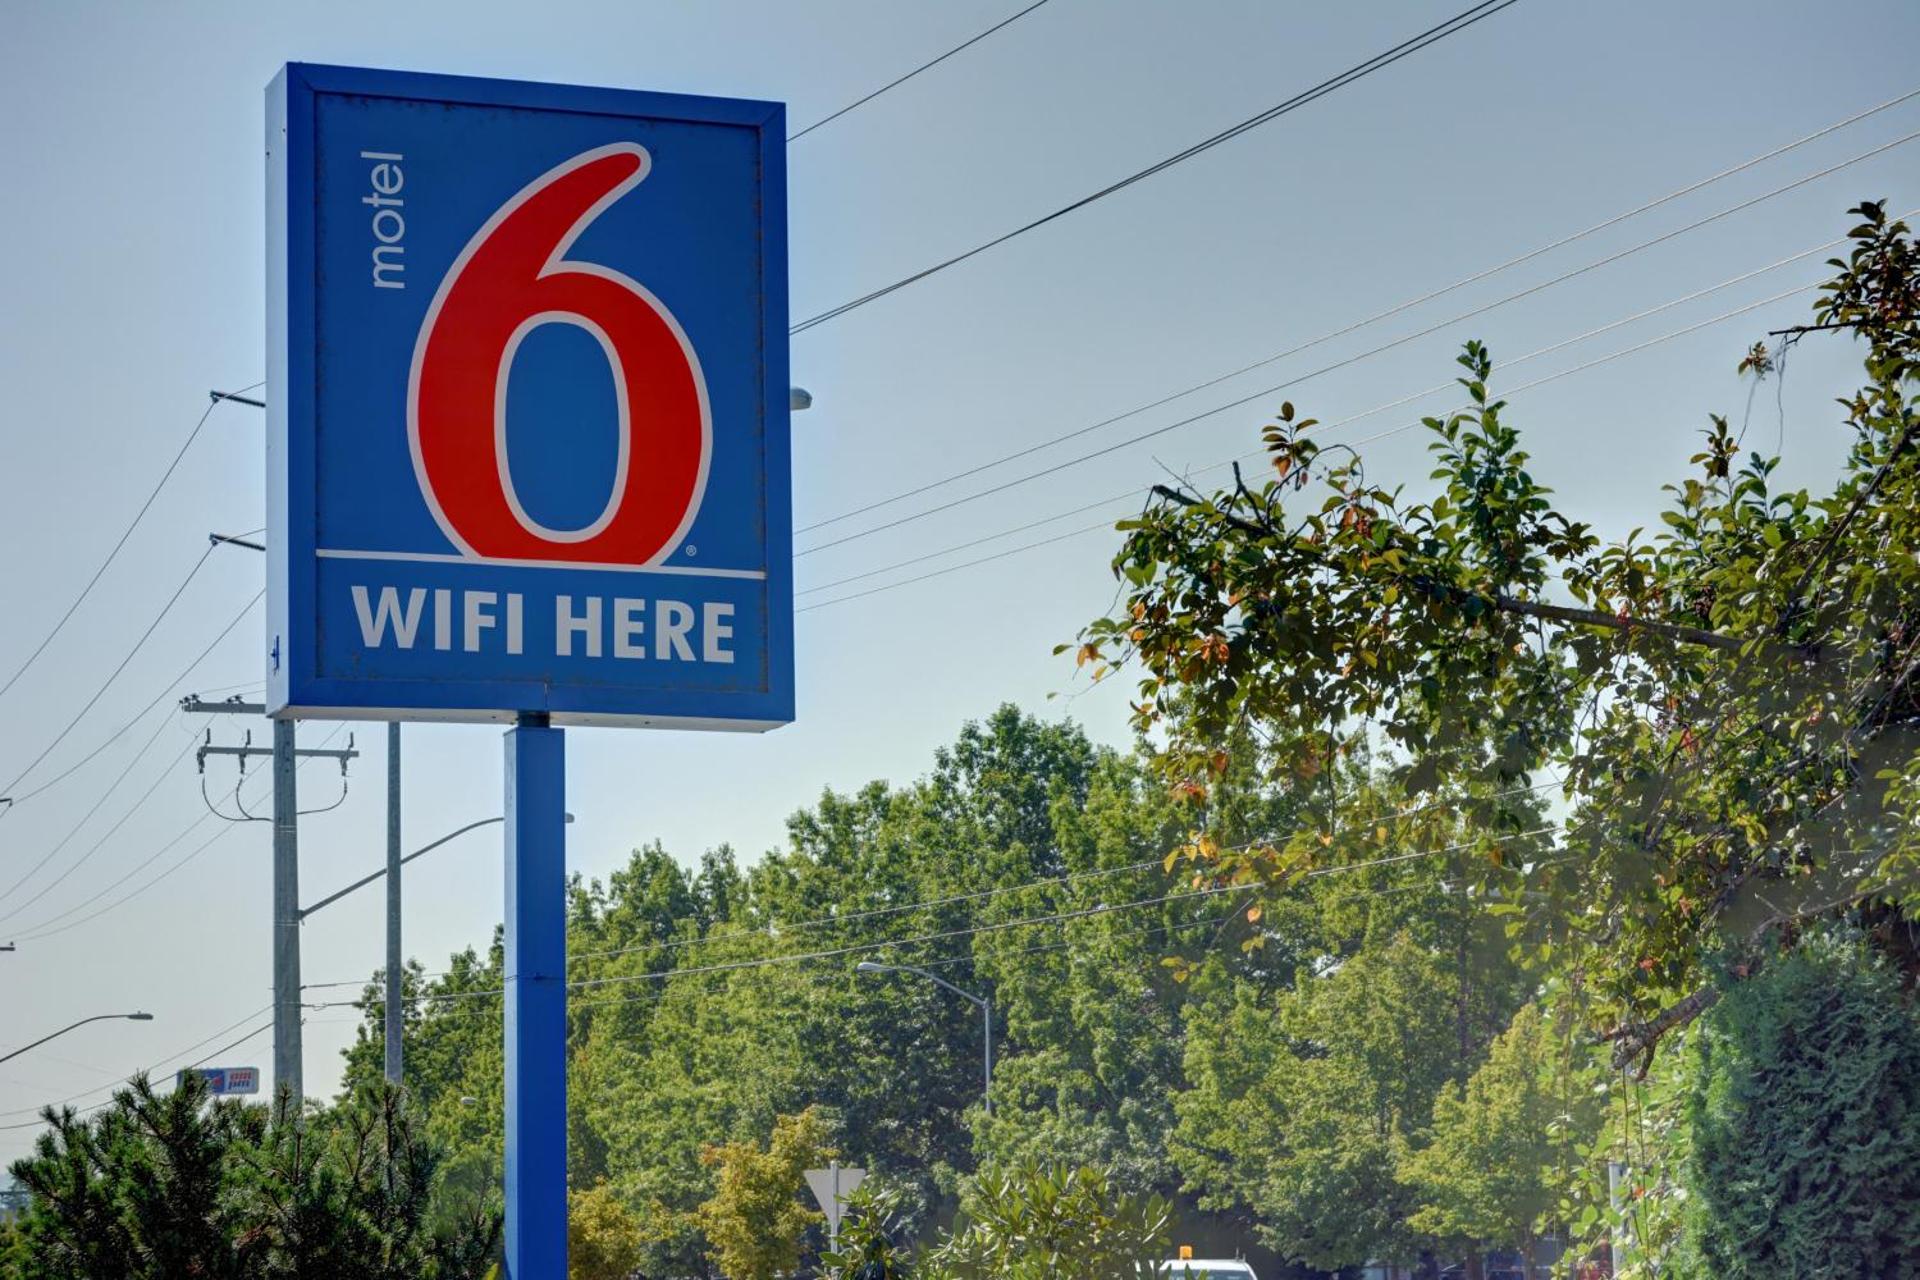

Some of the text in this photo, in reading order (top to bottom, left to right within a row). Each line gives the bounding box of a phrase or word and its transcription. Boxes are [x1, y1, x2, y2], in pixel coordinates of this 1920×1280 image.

[361, 151, 405, 289] motel
[407, 142, 713, 566] 6
[351, 586, 735, 664] WIFI HERE
